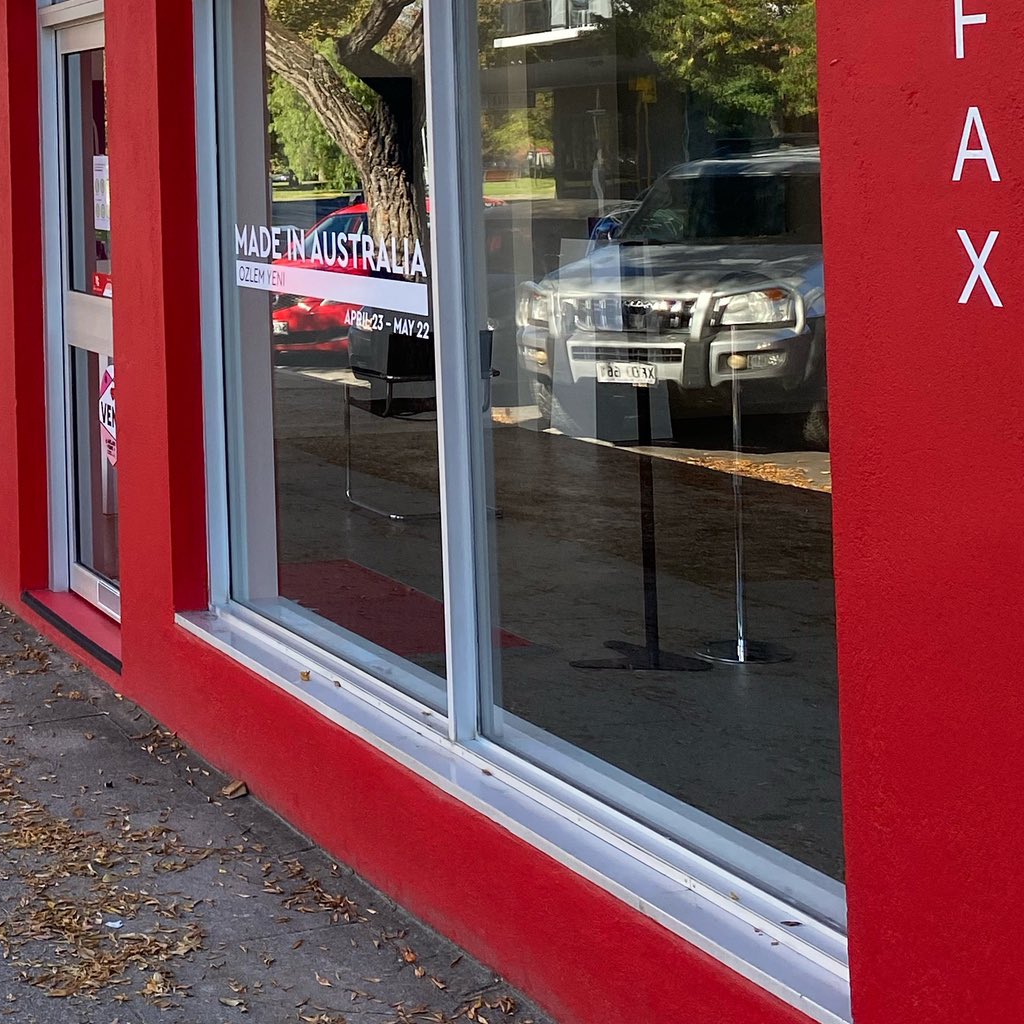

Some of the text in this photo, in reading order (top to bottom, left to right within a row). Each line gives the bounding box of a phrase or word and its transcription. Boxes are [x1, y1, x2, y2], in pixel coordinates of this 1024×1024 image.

[234, 224, 428, 278] MADE IN AUSTRALIA
[266, 269, 286, 287] YENI
[344, 309, 370, 327] APRIL
[372, 314, 384, 331] 23
[393, 317, 415, 336] MAY
[416, 321, 430, 339] 22
